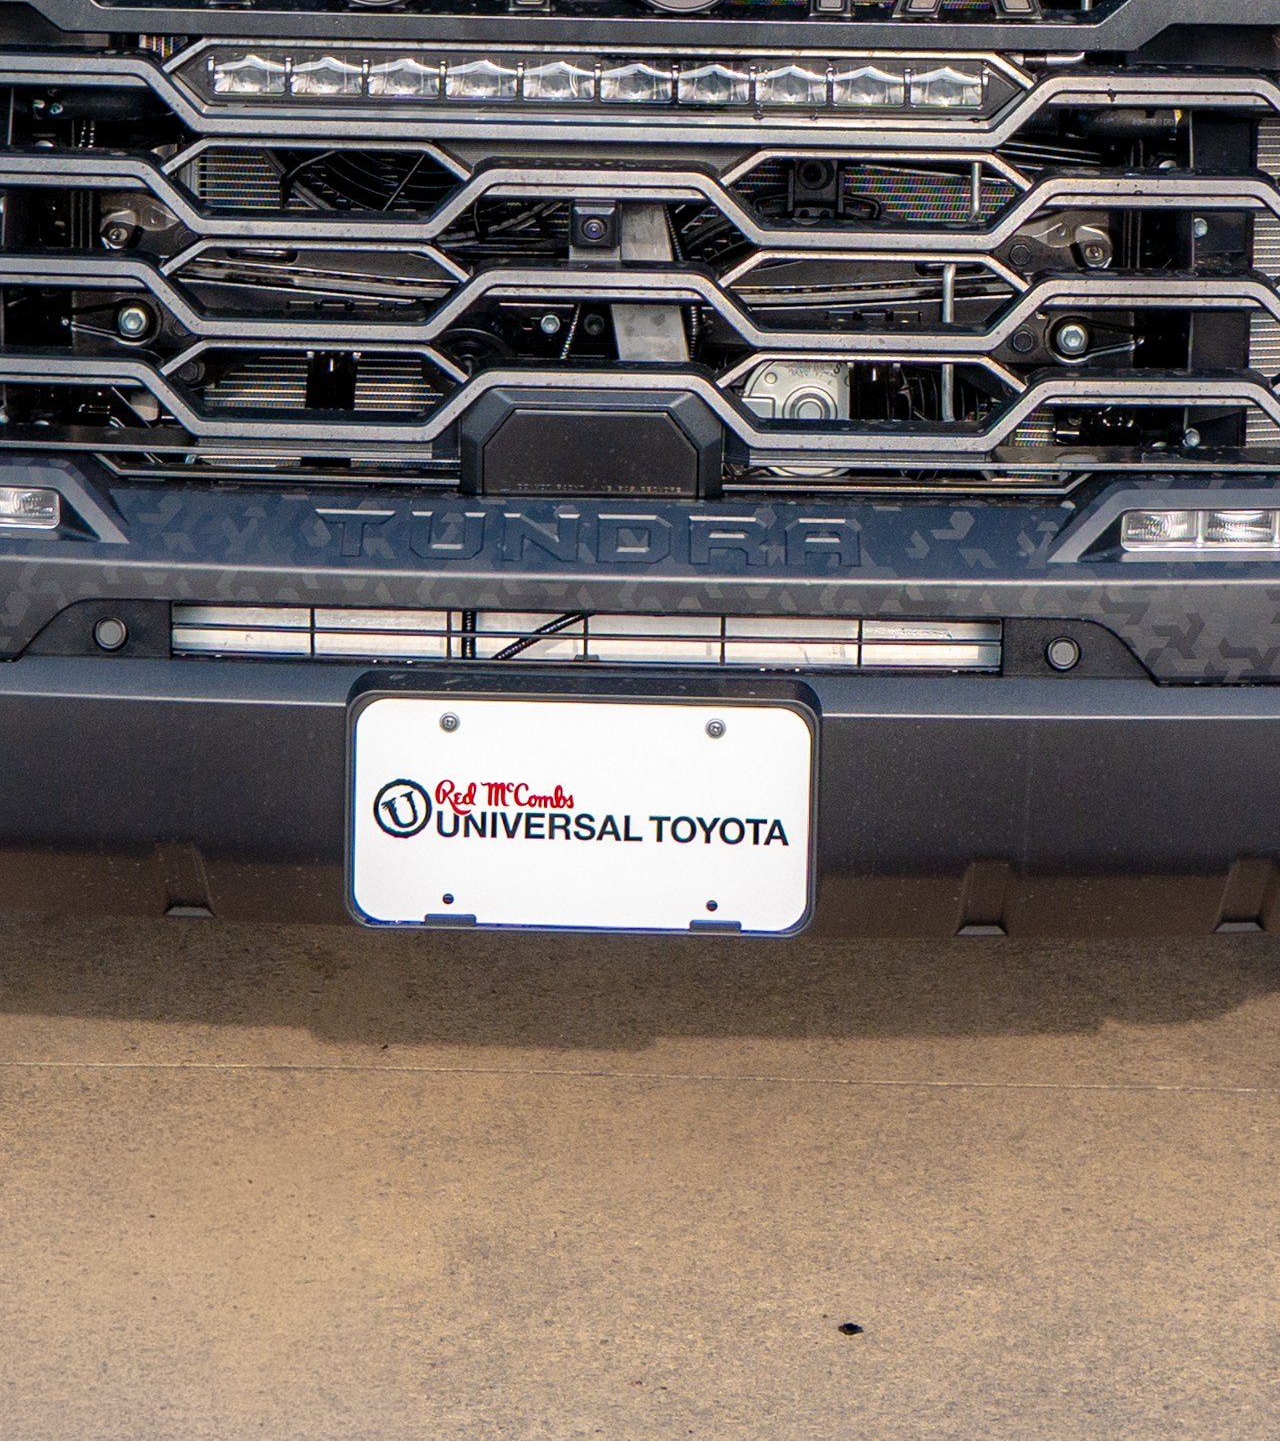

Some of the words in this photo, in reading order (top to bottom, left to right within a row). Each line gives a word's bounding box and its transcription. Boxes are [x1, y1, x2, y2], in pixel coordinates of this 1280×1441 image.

[315, 507, 864, 568] TUNDRA
[435, 779, 477, 816] Red
[480, 781, 575, 809] McCombs
[436, 809, 643, 843] UNIVERSAL
[649, 815, 790, 847] TOYOTA
